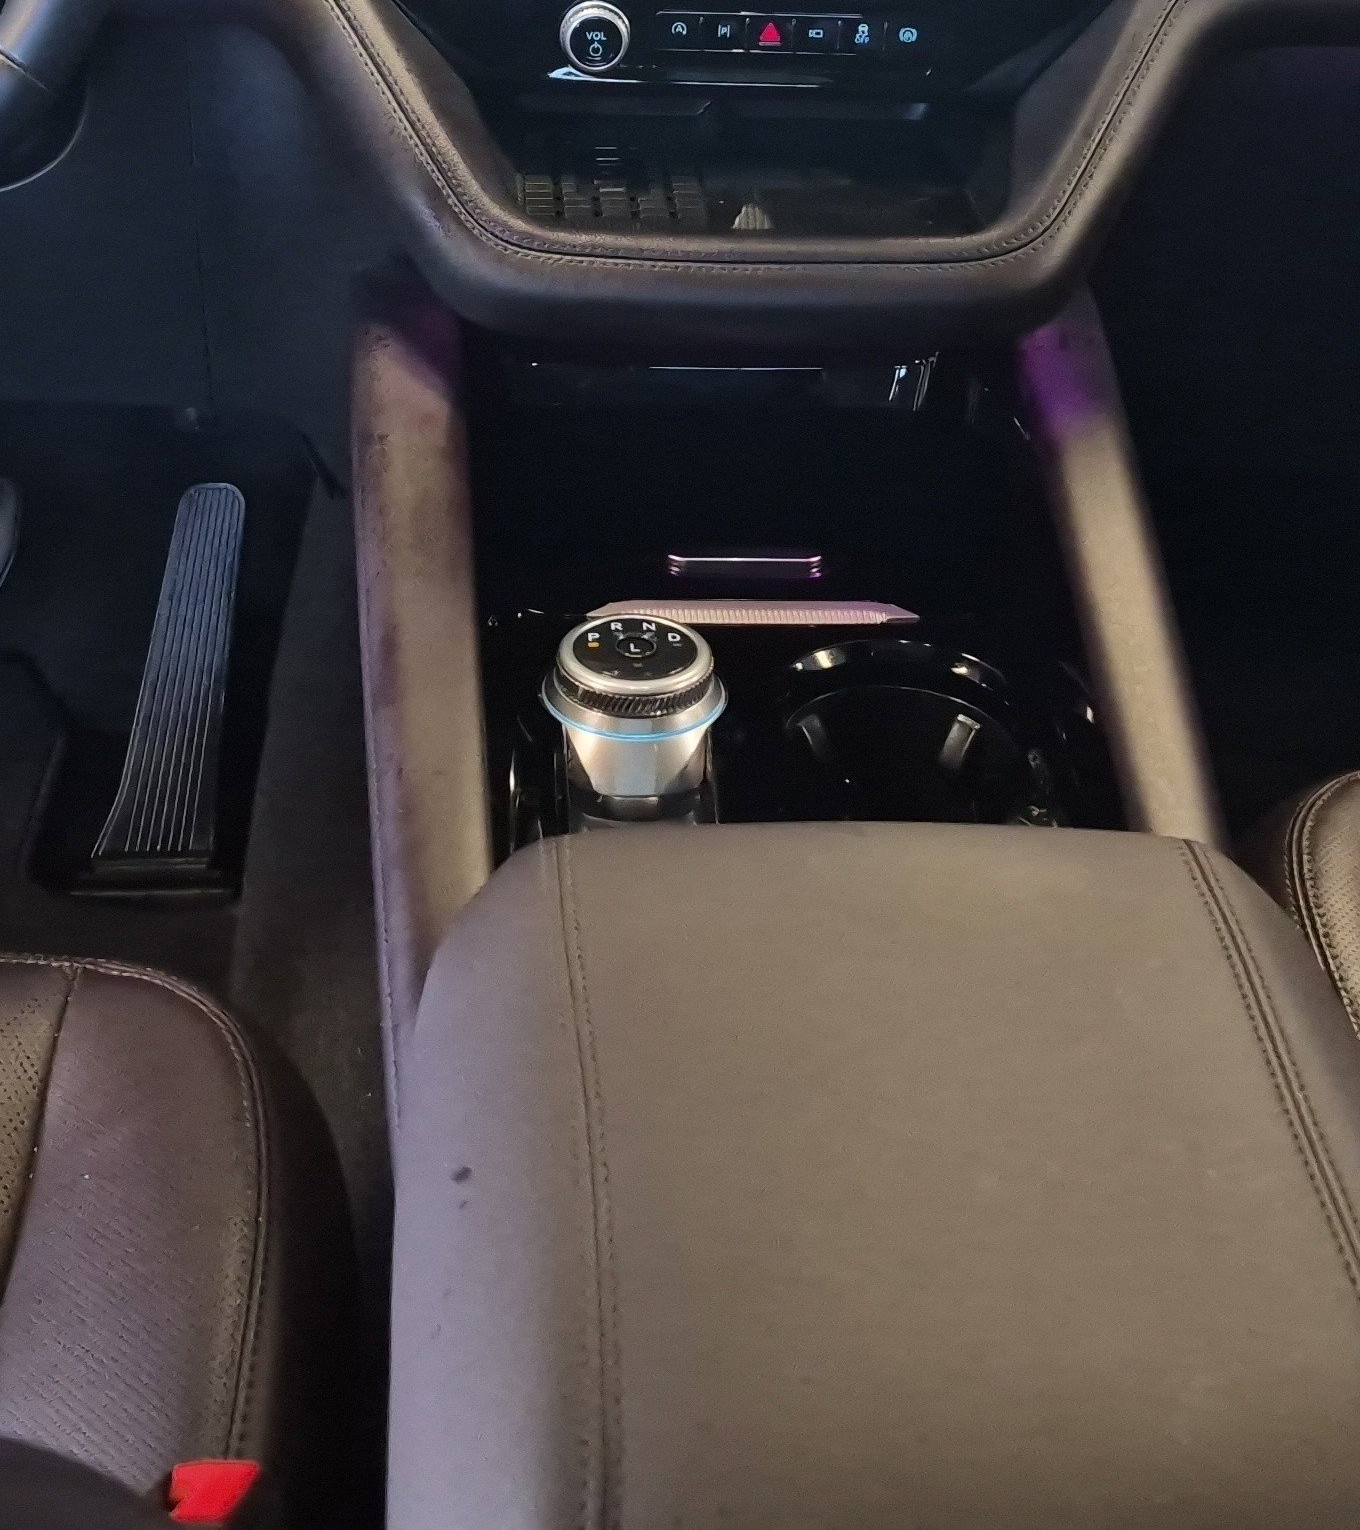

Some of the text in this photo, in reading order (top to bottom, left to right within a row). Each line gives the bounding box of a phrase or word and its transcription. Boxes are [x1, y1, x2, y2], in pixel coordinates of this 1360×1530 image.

[585, 30, 607, 42] VOL
[610, 621, 657, 631] R N
[587, 632, 681, 642] P D
[629, 642, 641, 652] L
